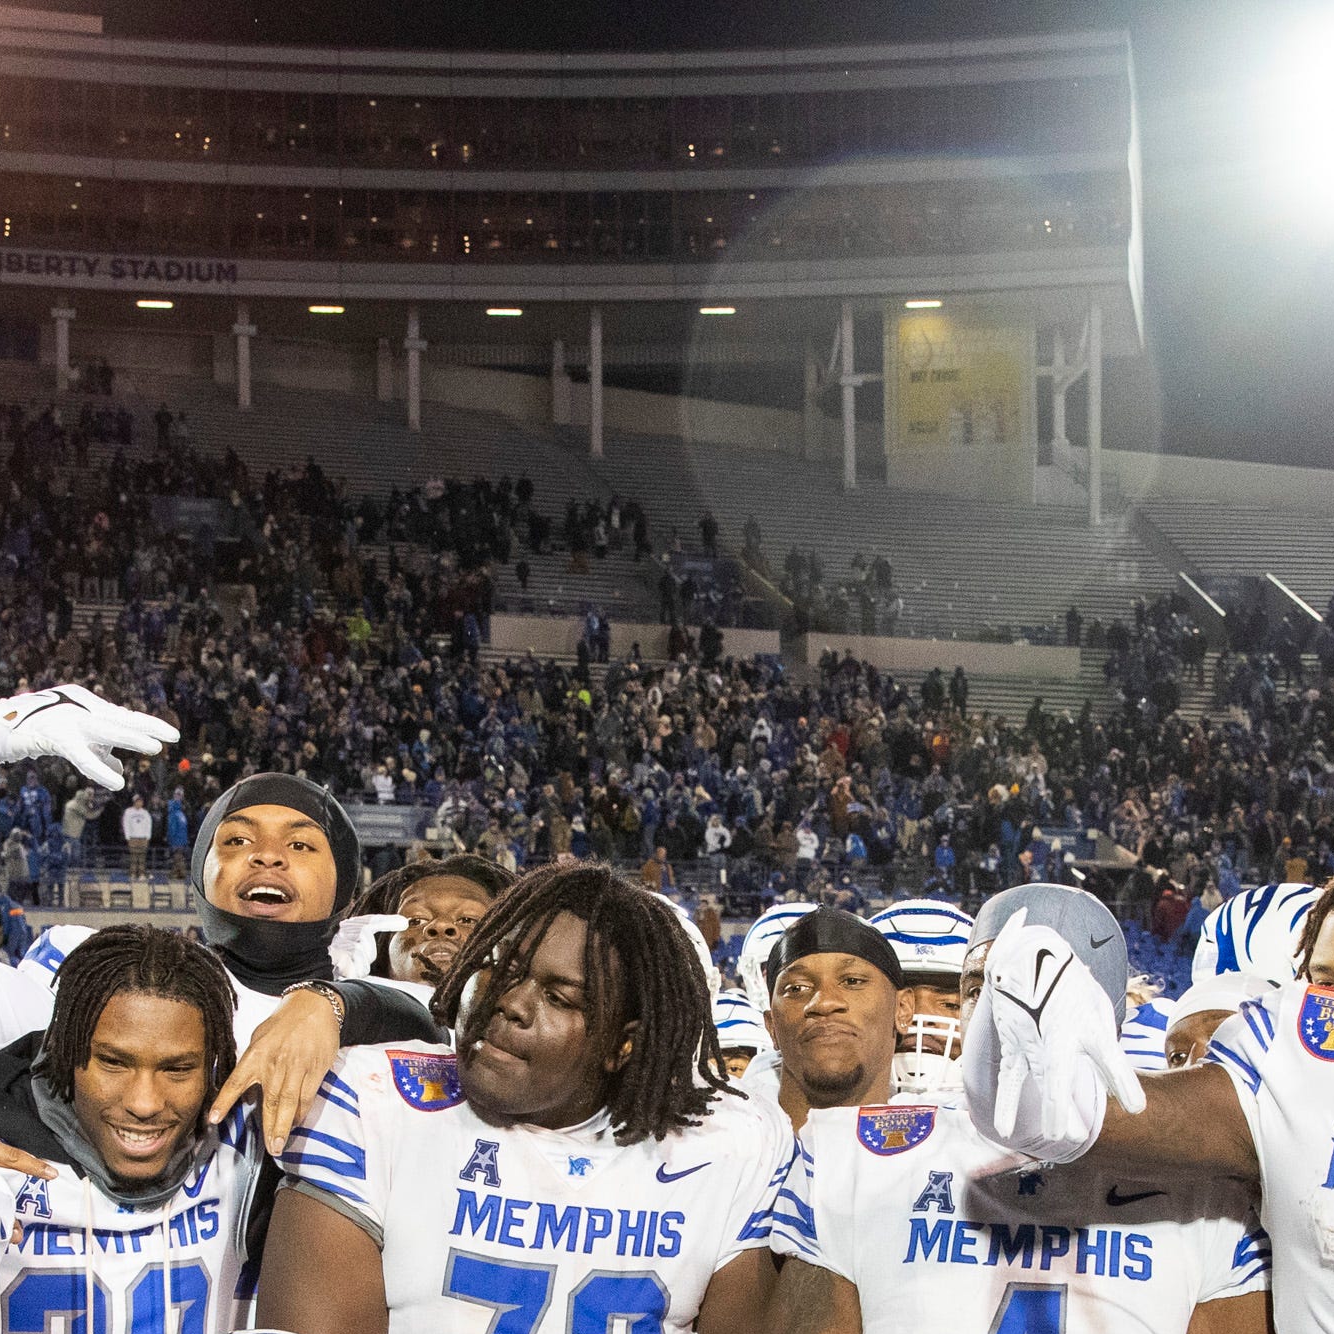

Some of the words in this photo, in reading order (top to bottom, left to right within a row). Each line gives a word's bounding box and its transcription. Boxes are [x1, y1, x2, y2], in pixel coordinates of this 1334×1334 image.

[111, 258, 239, 283] STADIUM
[447, 1188, 685, 1258] MEMPHIS
[902, 1218, 1153, 1282] MEMPHIS
